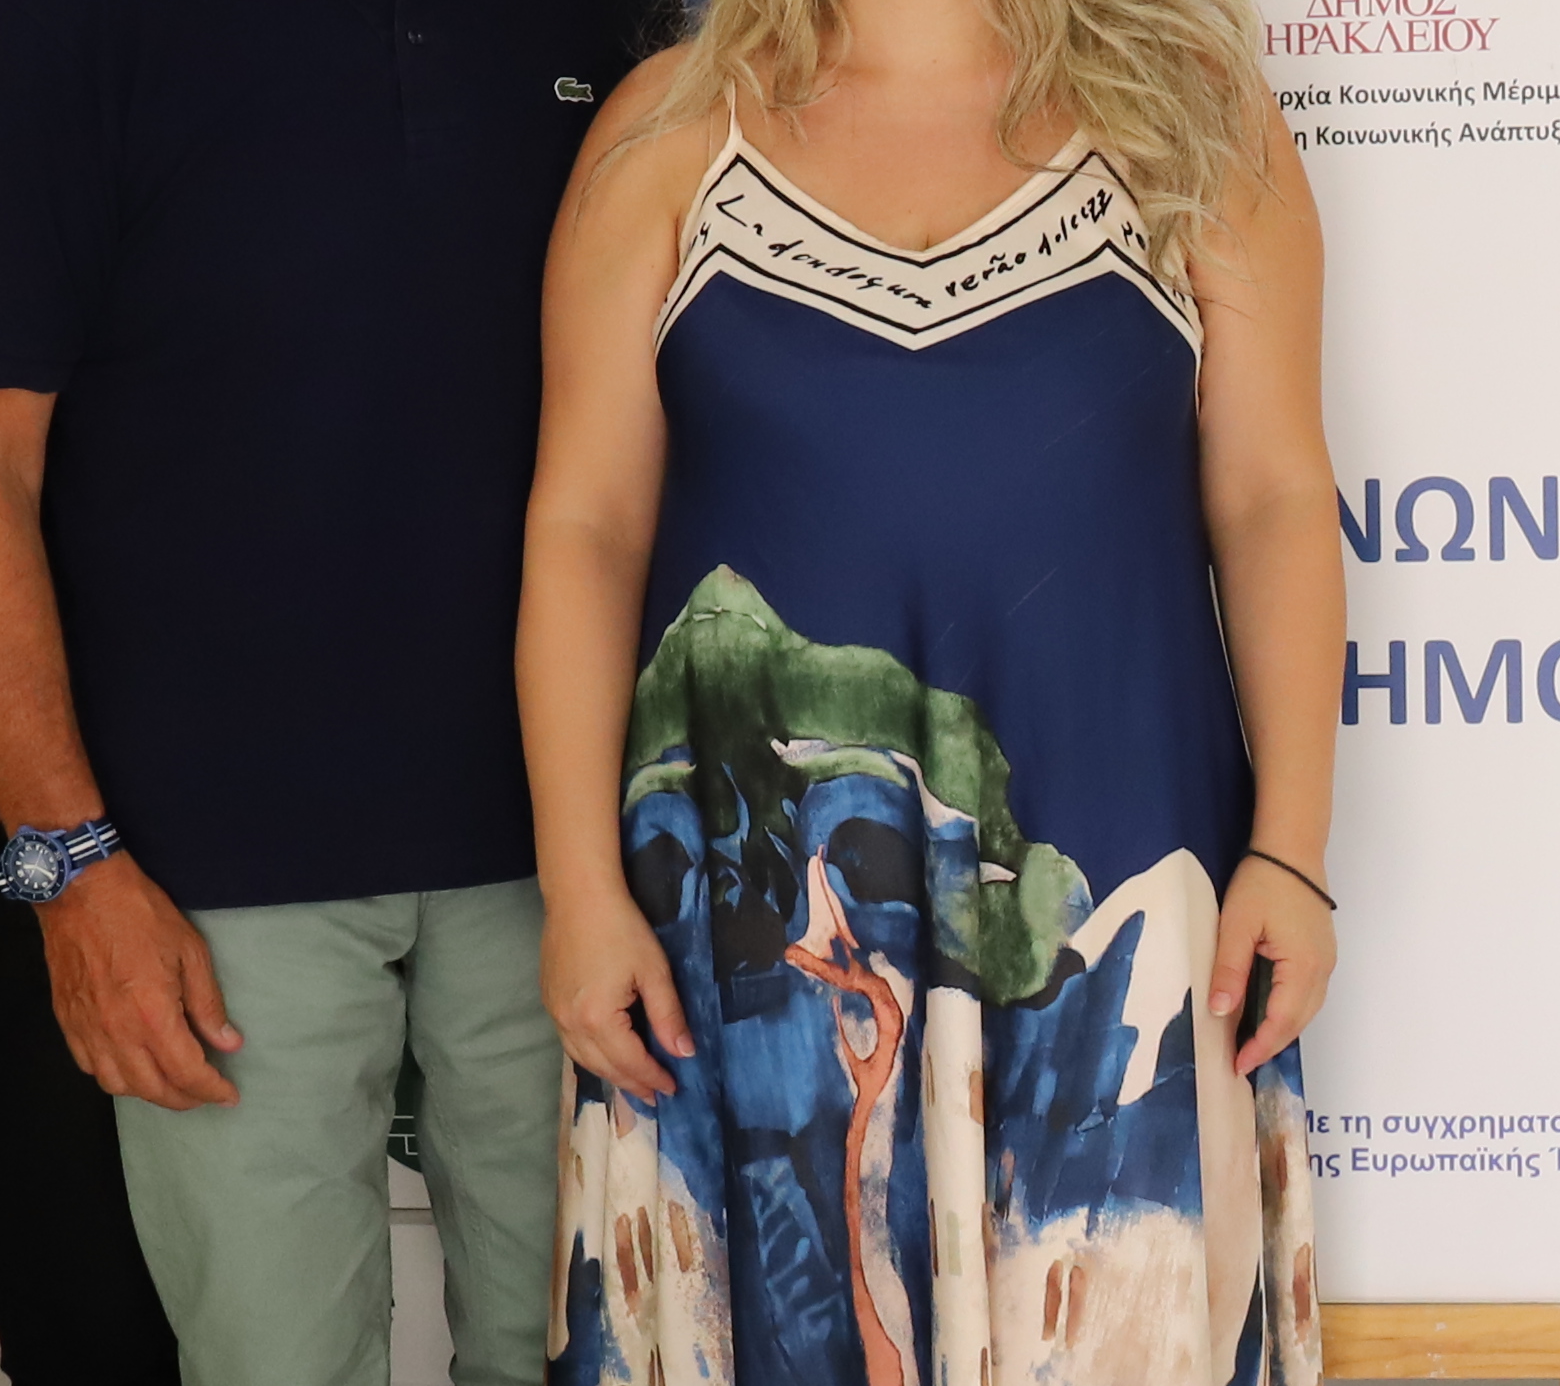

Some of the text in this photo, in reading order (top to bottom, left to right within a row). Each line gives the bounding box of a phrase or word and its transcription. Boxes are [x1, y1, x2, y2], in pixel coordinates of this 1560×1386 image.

[1264, 17, 1501, 56] ΗΡΑΚΛΕΙΟΥ
[1273, 84, 1332, 111] ρχία
[1339, 83, 1475, 107] Κοινωνικής
[1316, 124, 1452, 146] Κοινωνικής
[944, 252, 1028, 297] verão
[1340, 1115, 1372, 1139] τη
[1351, 1145, 1541, 1178] Ευρωπαϊκής
